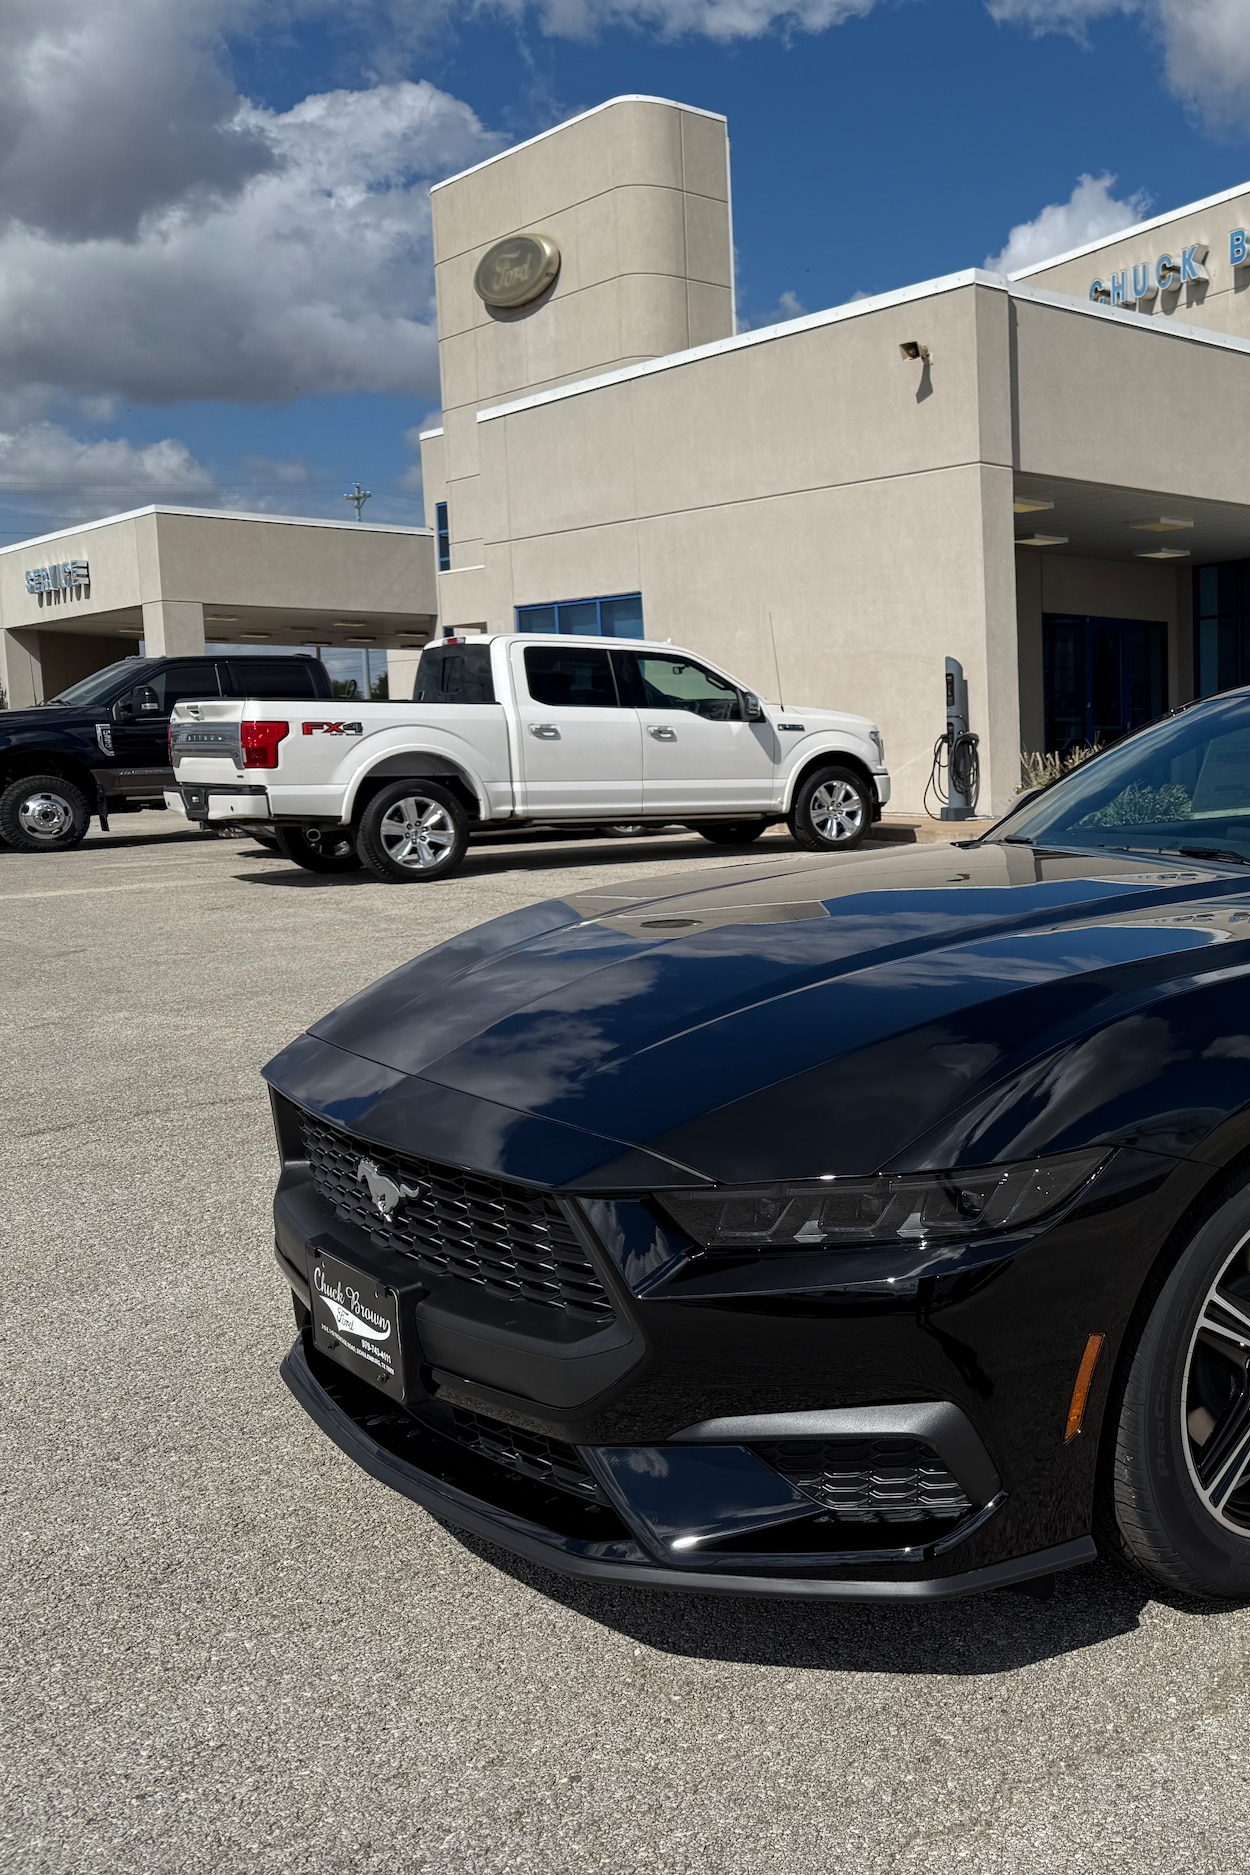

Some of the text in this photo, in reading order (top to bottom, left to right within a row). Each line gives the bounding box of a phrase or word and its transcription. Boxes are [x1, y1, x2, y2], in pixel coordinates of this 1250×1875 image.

[493, 249, 532, 291] Ford
[1089, 243, 1205, 306] CHUCK
[25, 560, 88, 594] SERVICE
[302, 721, 364, 736] FX4
[314, 1266, 391, 1331] Chuck Brown
[336, 1307, 355, 1331] Ford
